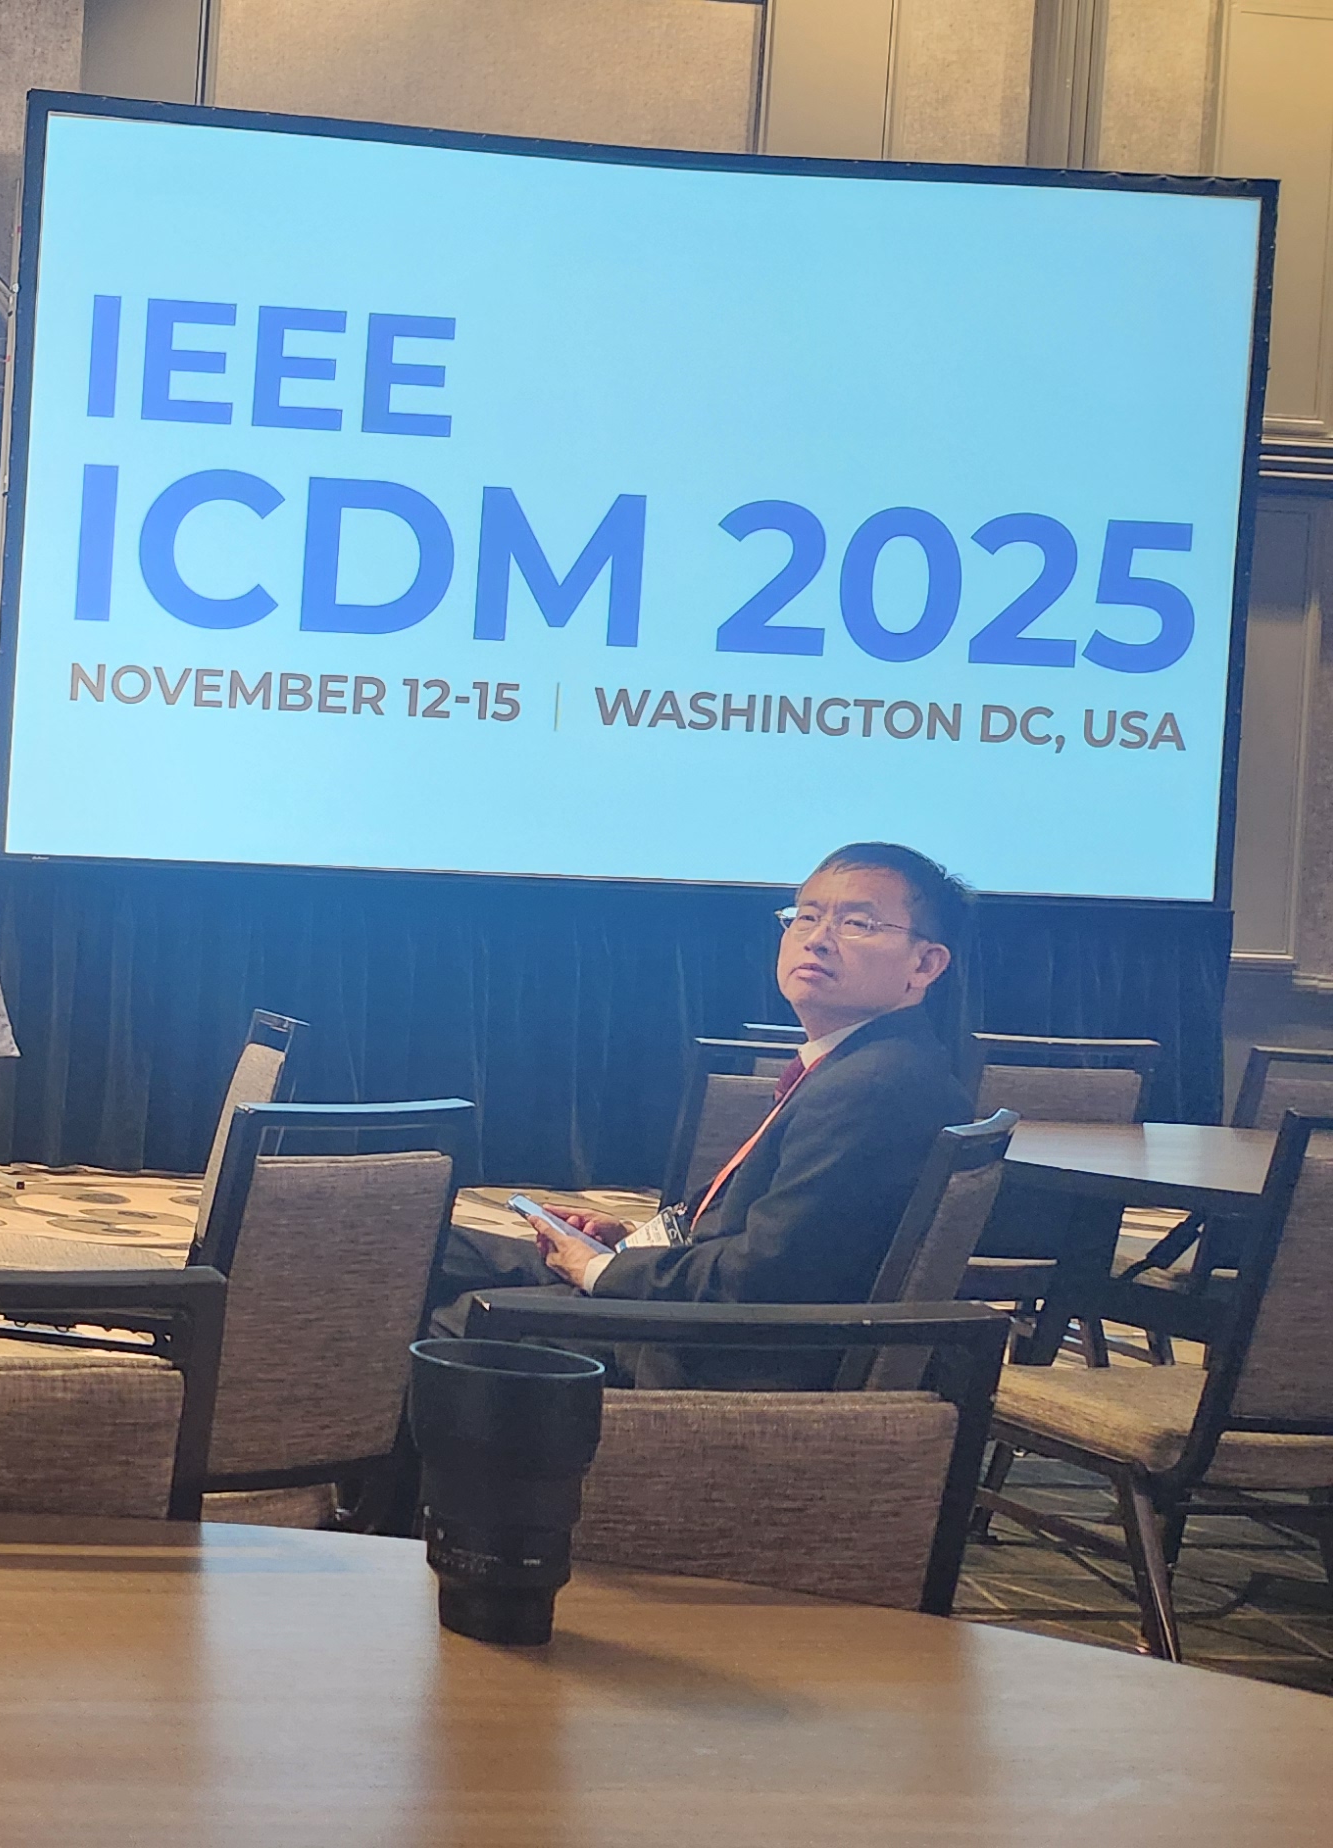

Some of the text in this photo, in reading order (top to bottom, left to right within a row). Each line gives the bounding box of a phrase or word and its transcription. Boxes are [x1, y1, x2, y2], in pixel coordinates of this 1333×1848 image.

[86, 294, 457, 439] IEEE
[74, 463, 1196, 675] ICDM 2025
[69, 662, 1187, 755] NOVEMBER 12-15 WASHINGTON DC, USA
